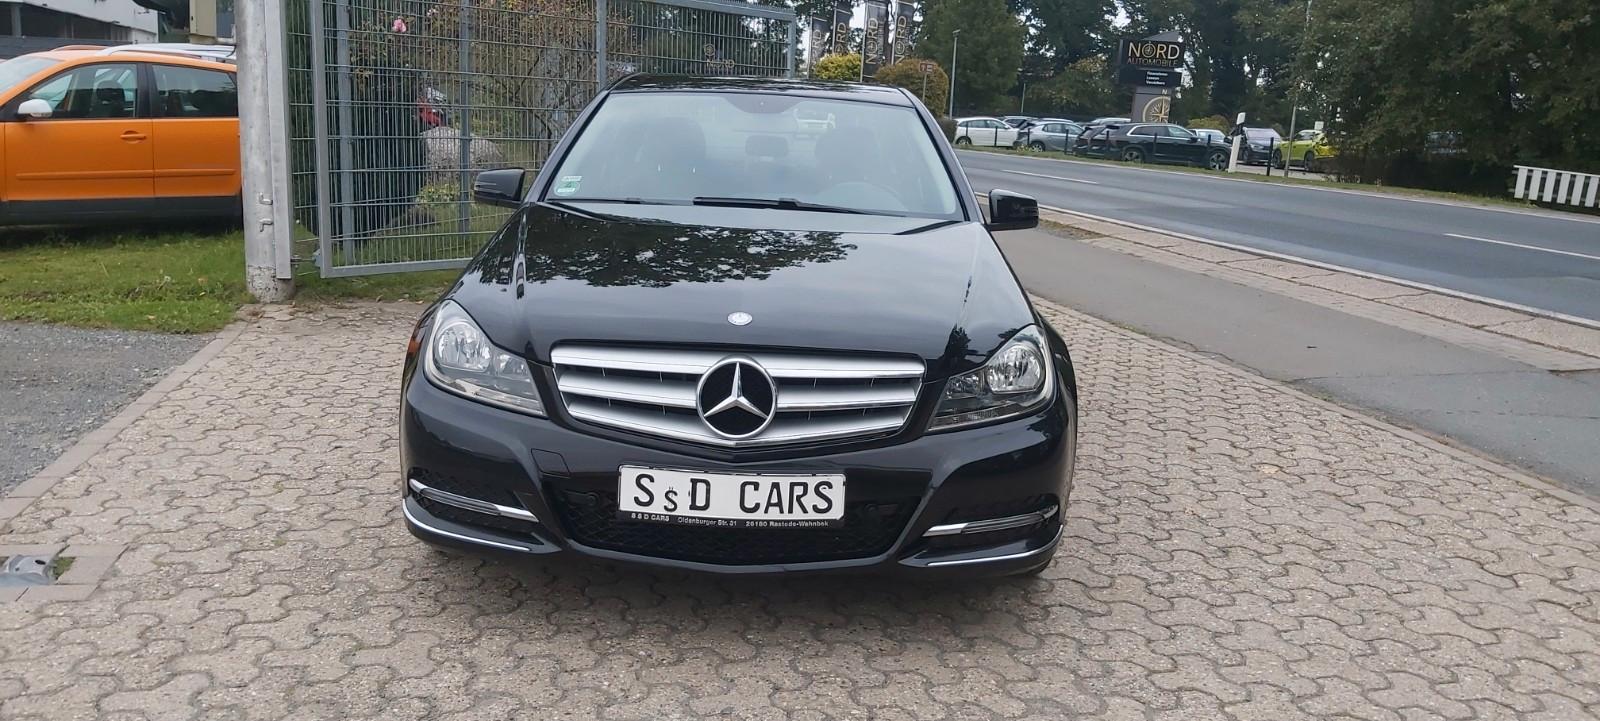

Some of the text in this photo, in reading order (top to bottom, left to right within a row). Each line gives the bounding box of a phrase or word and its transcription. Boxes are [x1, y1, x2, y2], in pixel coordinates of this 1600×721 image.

[865, 17, 879, 64] NORD
[1128, 42, 1180, 59] NORD
[1127, 58, 1178, 67] AUTOMOBILE
[739, 481, 833, 514] CARS
[651, 514, 670, 522] CARS
[677, 516, 717, 526] Oldenburger
